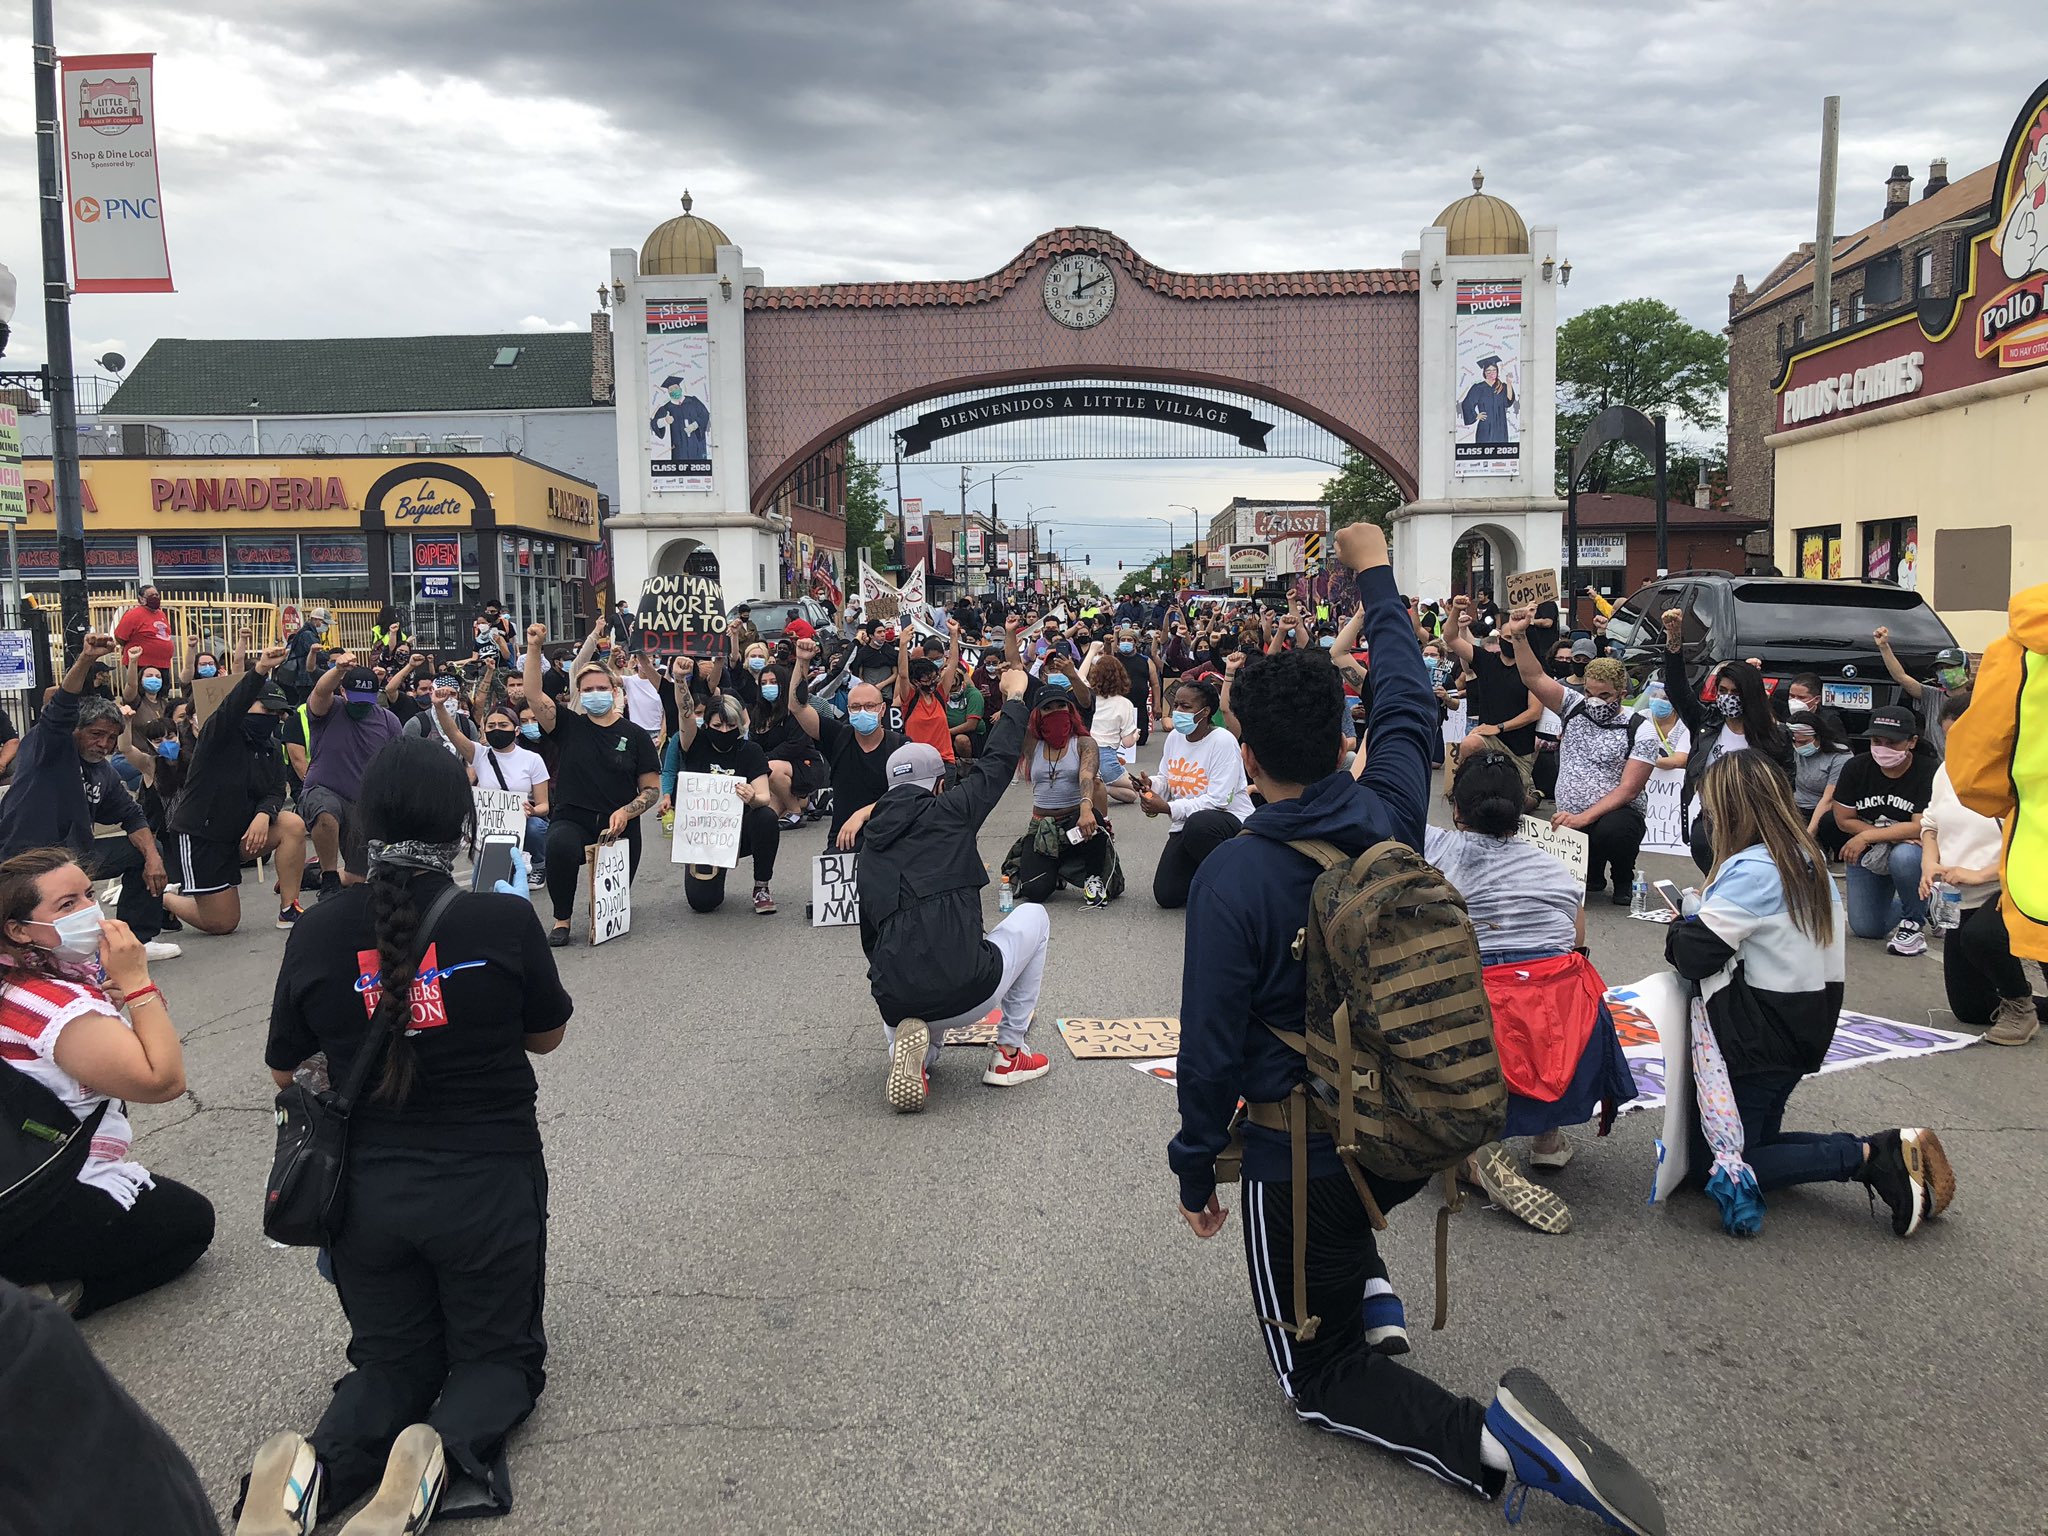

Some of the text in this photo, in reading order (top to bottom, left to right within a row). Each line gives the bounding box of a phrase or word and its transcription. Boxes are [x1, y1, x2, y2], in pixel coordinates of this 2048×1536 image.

[93, 106, 128, 115] VILLAGE
[97, 98, 122, 107] LITTLE
[71, 148, 152, 161] Shop & Dine Local
[91, 160, 135, 169] Sponsored by:
[104, 197, 158, 220] PNC
[1063, 263, 1070, 272] 11
[1075, 260, 1083, 270] 12
[1090, 263, 1094, 273] 1
[1053, 273, 1062, 283] 10
[1051, 287, 1059, 297] 9
[1100, 286, 1107, 295] 3
[1489, 283, 1503, 294] se
[676, 303, 690, 314] se
[1054, 299, 1062, 309] 8
[1096, 298, 1103, 308] 4
[1470, 296, 1510, 315] pudo!!
[1063, 309, 1070, 319] 7
[1075, 312, 1084, 322] 6
[1088, 309, 1096, 319] 5
[1982, 292, 2036, 339] Pollo
[658, 314, 698, 334] pudo!!
[2009, 348, 2019, 358] NO
[2019, 346, 2032, 357] HAY
[1783, 351, 1925, 425] POLLOS & CARNES
[940, 395, 1229, 430] BIENVENIDOS A LITTLE VILLAGE
[1457, 446, 1518, 456] CLASS OF 2020
[652, 463, 711, 472] CLASS OF 2020
[1, 489, 23, 501] PRIVADO
[150, 477, 348, 513] PANADERIA
[416, 480, 435, 502] La
[4, 502, 23, 513] MALL
[395, 496, 461, 524] Baguette
[1584, 537, 1624, 547] NATURALEZA
[154, 549, 224, 565] PASTELES
[237, 547, 291, 563] CAKES
[311, 547, 362, 563] CAKES
[415, 543, 459, 567] OPEN
[641, 575, 724, 600] HOW MANY
[1509, 586, 1535, 605] COPS
[656, 594, 719, 615] MORE
[639, 612, 727, 634] HAVE TO
[644, 630, 724, 657] DIE?!
[24, 632, 34, 687] WARNING
[1841, 692, 1870, 705] 13985
[686, 777, 703, 793] EL
[499, 793, 521, 812] LIVES
[1855, 795, 1885, 811] BLACK
[479, 808, 506, 829] MATTER
[1542, 826, 1582, 855] Country
[604, 875, 621, 893] NO
[605, 915, 624, 938] NO
[1065, 1019, 1170, 1031] LIVES
